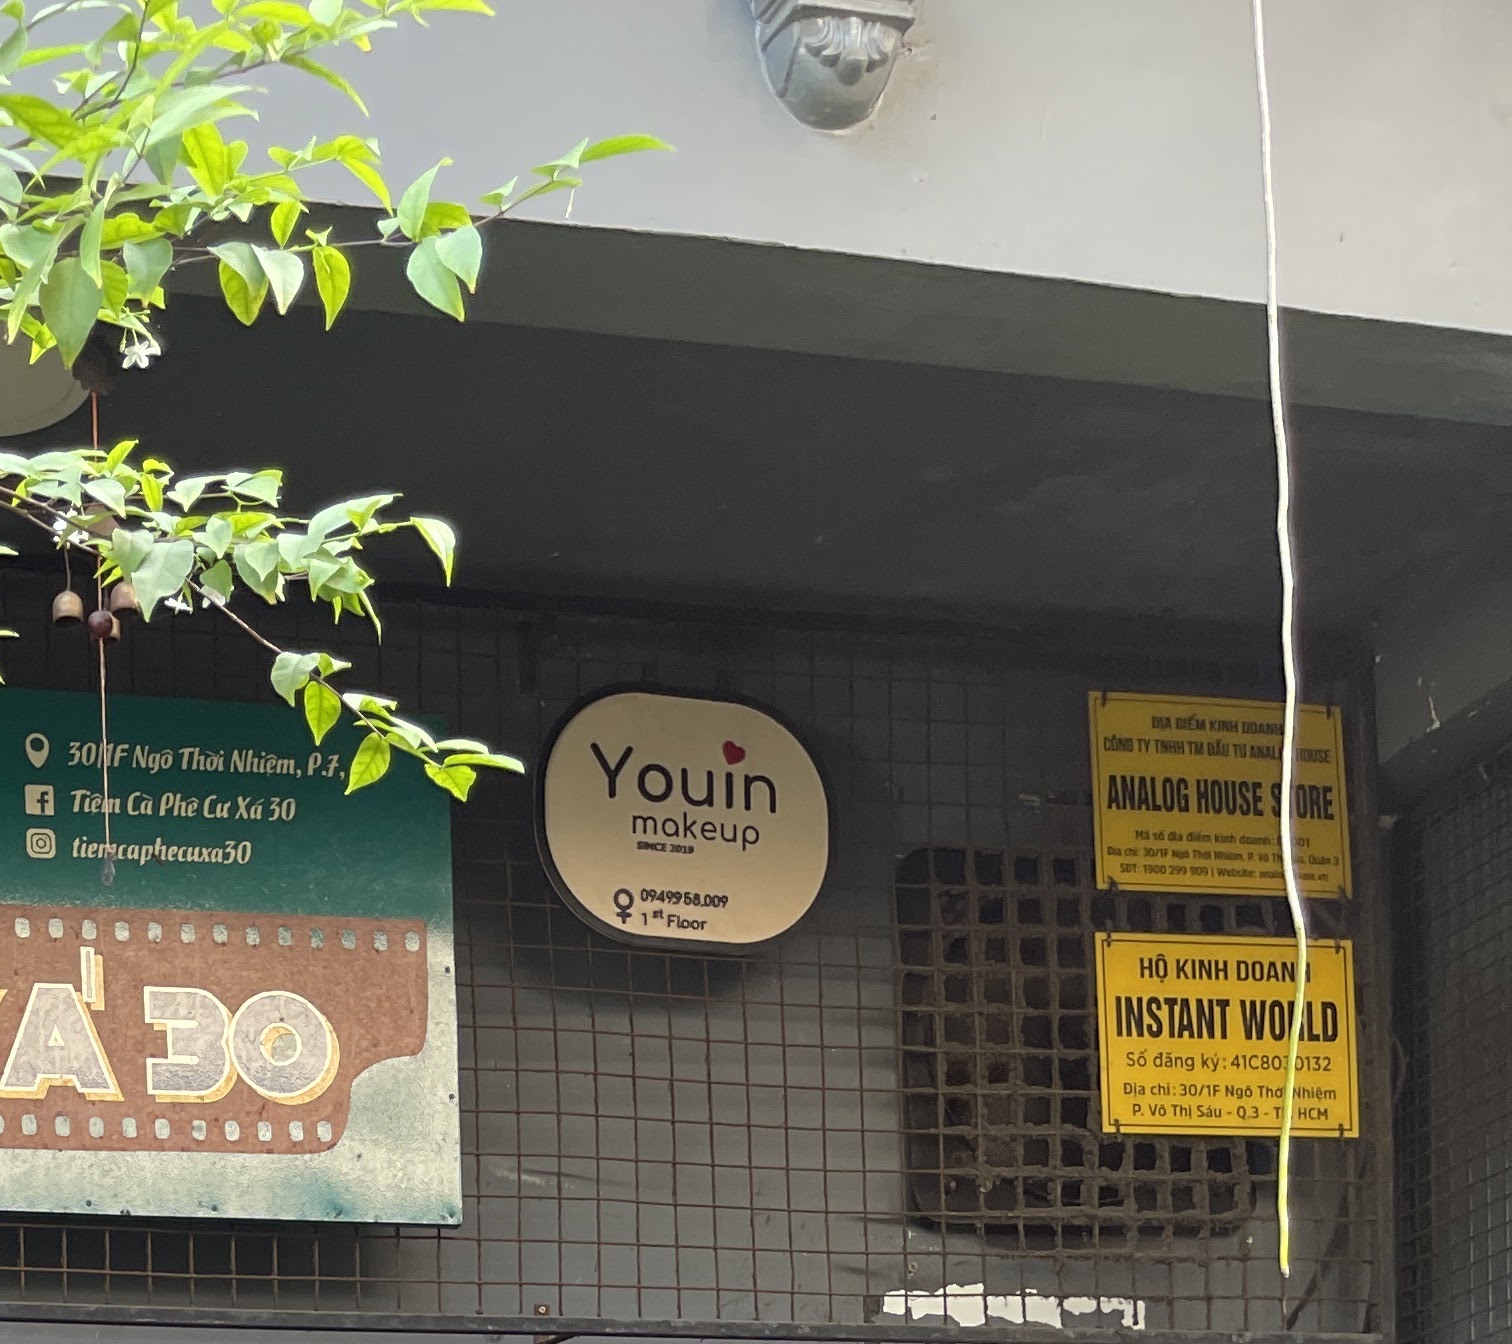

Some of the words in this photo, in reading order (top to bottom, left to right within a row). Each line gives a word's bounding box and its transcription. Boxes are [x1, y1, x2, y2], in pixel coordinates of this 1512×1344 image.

[1210, 719, 1238, 733] KINH
[1137, 738, 1150, 753] TY
[133, 744, 173, 774] Ngô
[179, 746, 224, 772] Thời
[230, 749, 302, 779] Nhiệm,
[590, 741, 777, 814] Youin
[71, 789, 121, 817] Tiệm
[127, 791, 154, 816] Cà
[159, 792, 199, 818] Phê
[203, 794, 232, 819] Cư
[235, 796, 264, 820] Xá
[268, 797, 296, 821] 30
[1107, 774, 1190, 813] ANALOG
[1195, 778, 1264, 817] HOUSE
[1270, 782, 1335, 821] SORE
[632, 811, 760, 851] makeup
[72, 837, 252, 866] tiemcaphecuxa30
[637, 841, 667, 852] SINCE
[666, 914, 707, 931] Floor
[1139, 953, 1168, 984] HỘ
[1176, 958, 1229, 981] KINH
[1115, 995, 1231, 1041] INSTANT
[144, 985, 341, 1106] 30
[1126, 1048, 1148, 1068] Số
[1153, 1051, 1196, 1072] đăng
[1123, 1082, 1145, 1099] Địa
[1179, 1083, 1221, 1098] 30/1F
[1225, 1082, 1253, 1101] Ngô
[1293, 1086, 1337, 1103] Nhiệm
[1132, 1103, 1145, 1118] P.
[1148, 1103, 1167, 1118] Võ
[1172, 1104, 1192, 1121] Thị
[1196, 1103, 1222, 1119] Sáu
[1297, 1106, 1329, 1121] HCM
